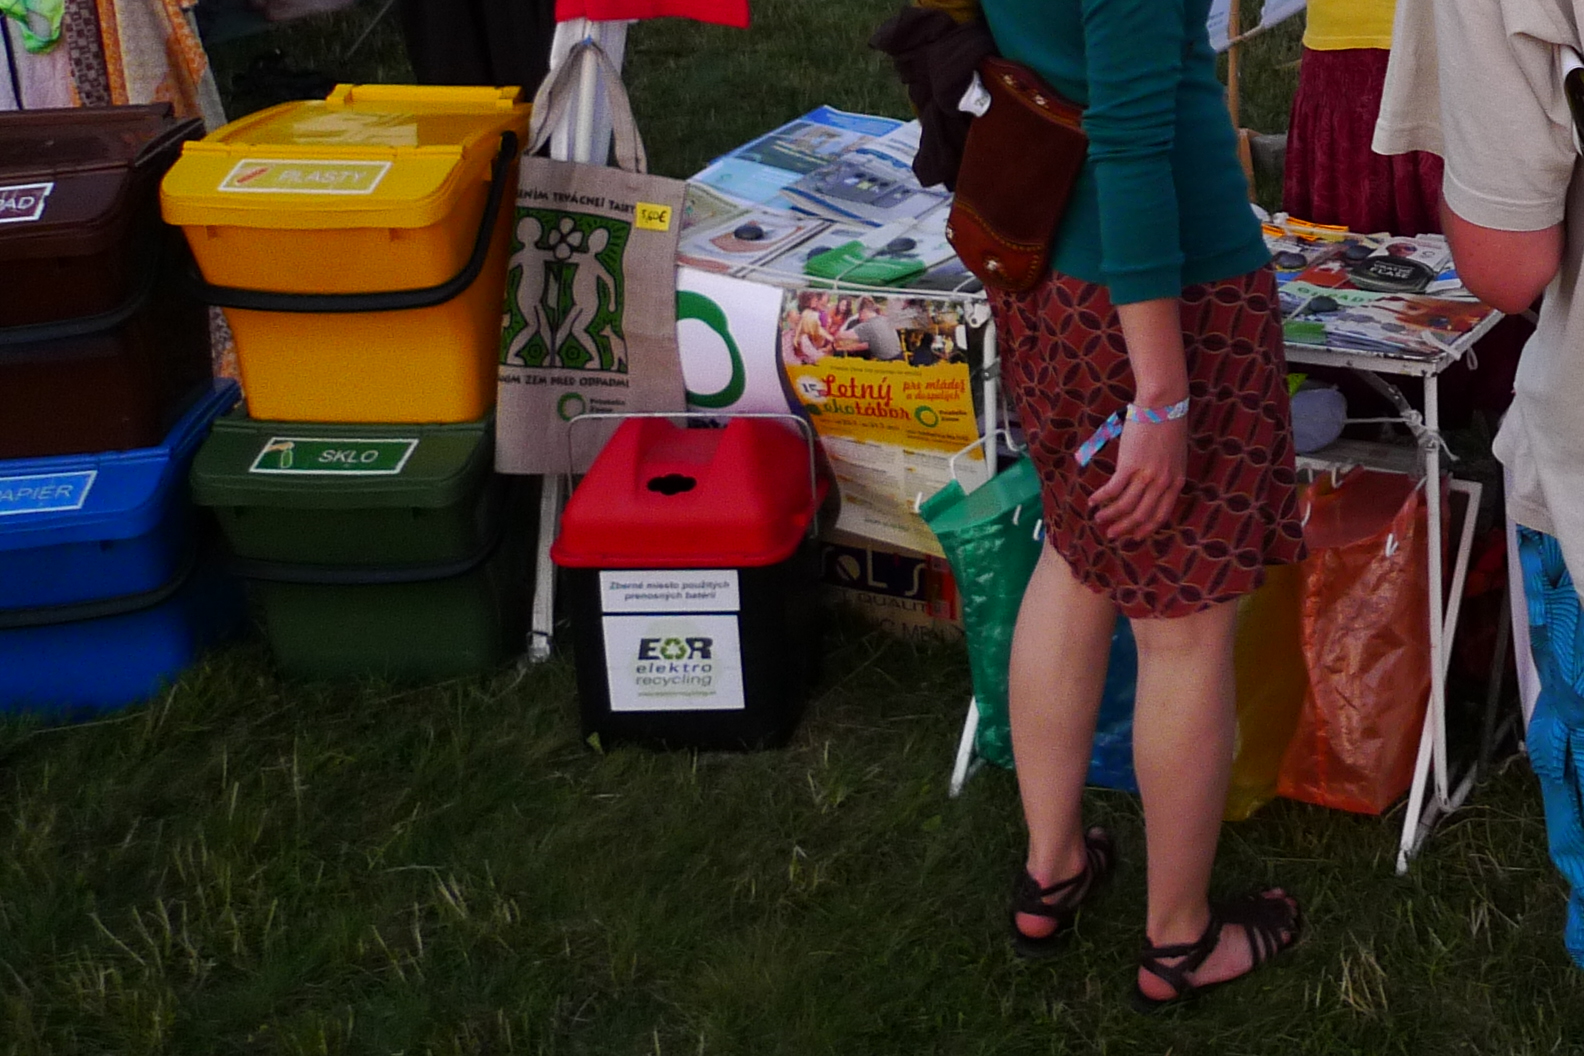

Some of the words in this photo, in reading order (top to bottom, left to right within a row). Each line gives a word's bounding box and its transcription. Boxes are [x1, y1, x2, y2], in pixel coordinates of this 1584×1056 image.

[277, 169, 366, 183] PLASTY
[818, 374, 893, 407] Letný
[318, 449, 379, 463] SKLO
[0, 484, 73, 503] APIER
[636, 663, 712, 674] elektro
[636, 673, 712, 687] recycling
